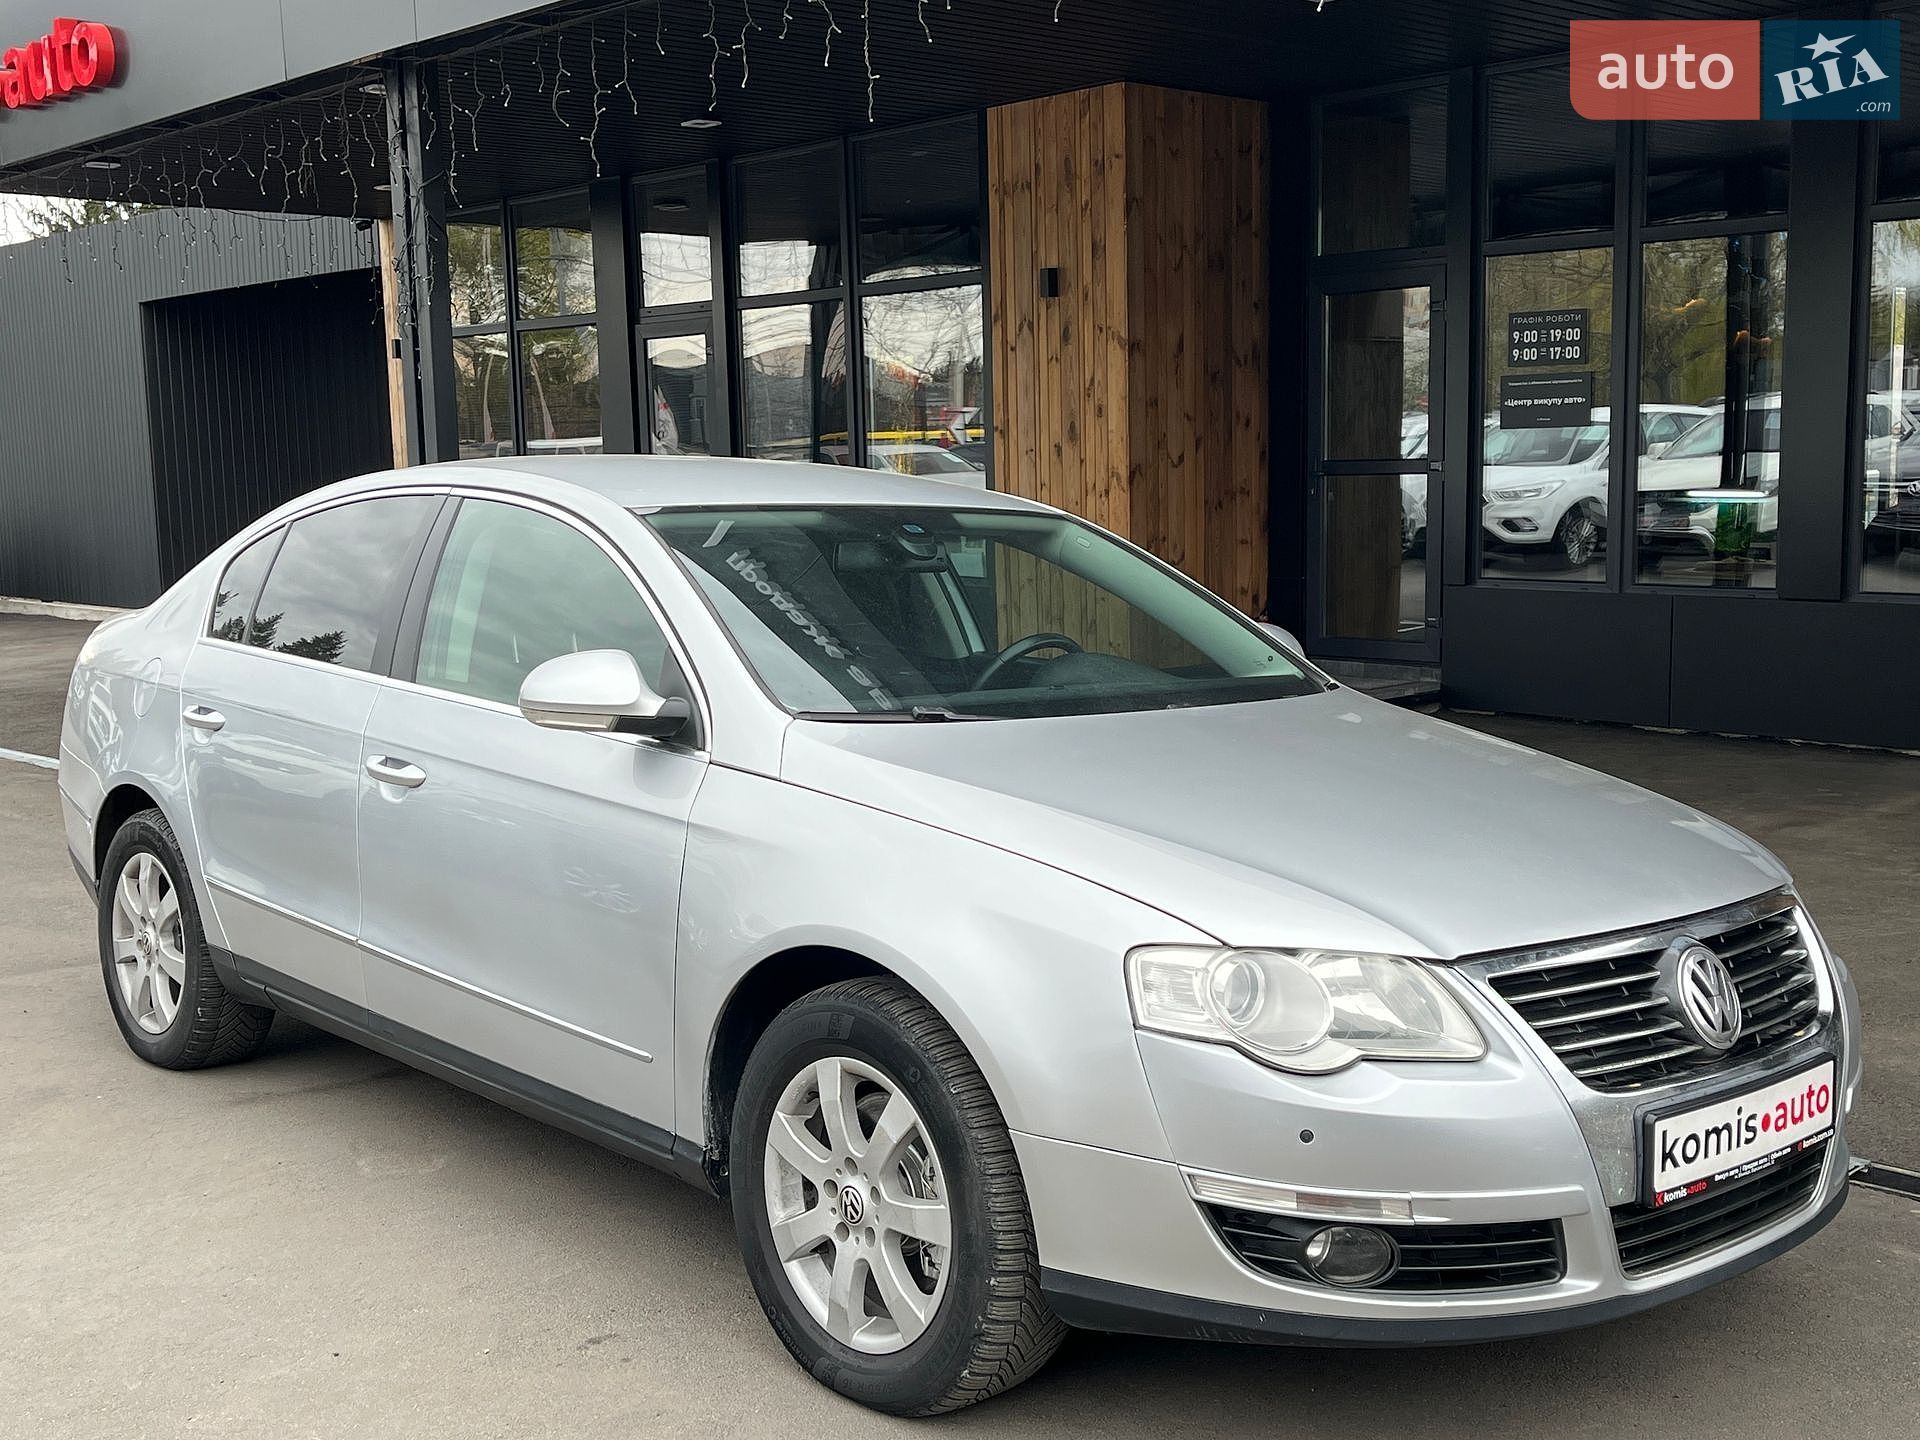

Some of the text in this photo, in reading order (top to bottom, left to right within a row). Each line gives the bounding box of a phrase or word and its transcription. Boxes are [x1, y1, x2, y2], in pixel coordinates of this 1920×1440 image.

[2, 17, 115, 109] auto
[1513, 314, 1581, 325] ГРАФІК РОБОТИ
[1513, 328, 1581, 343] 9:00 19:00
[1513, 346, 1580, 361] 9:00 17:00
[1504, 396, 1586, 407] «Центр викупу авто»
